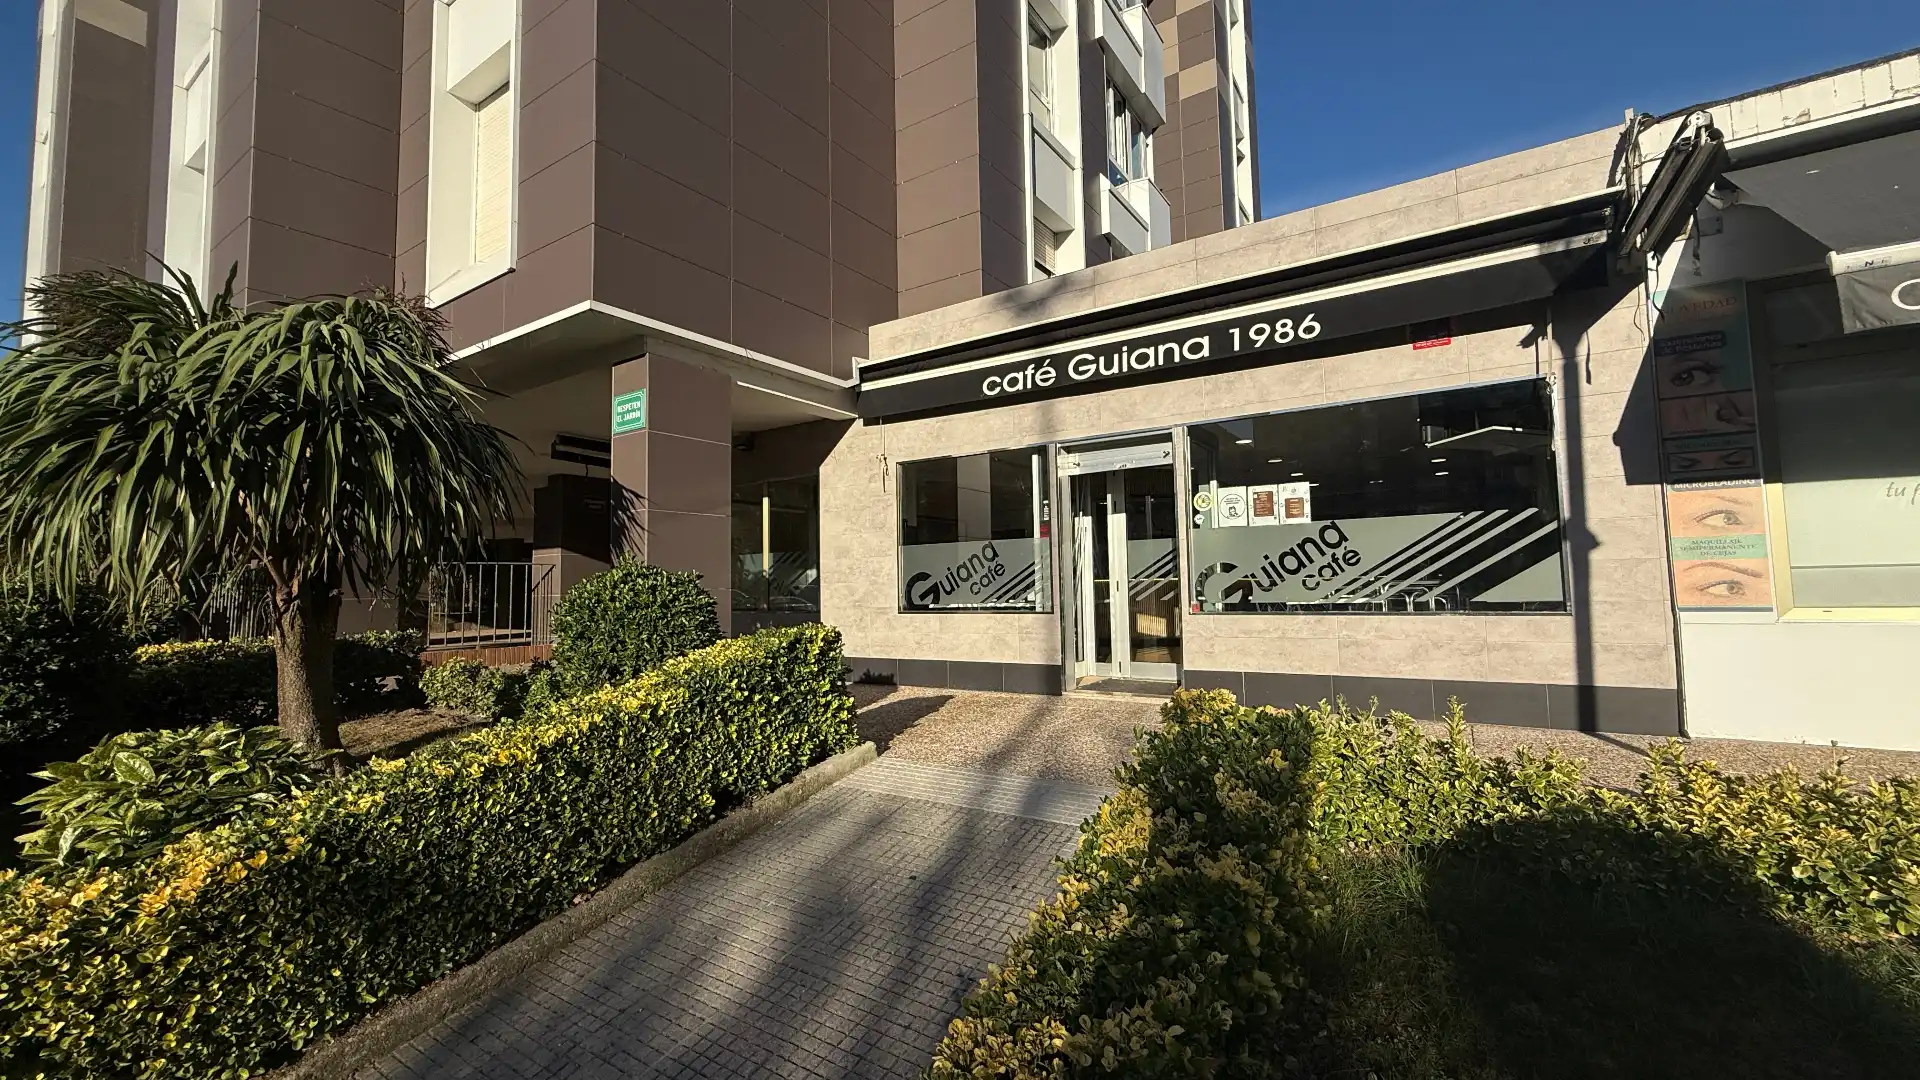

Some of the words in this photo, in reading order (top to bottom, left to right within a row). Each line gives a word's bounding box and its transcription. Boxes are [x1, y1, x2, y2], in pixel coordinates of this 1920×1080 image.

[982, 359, 1057, 396] café
[1067, 335, 1210, 381] Guiana
[1228, 313, 1321, 352] 1986
[617, 401, 641, 413] RESPETEN
[1674, 478, 1755, 489] MICROBLADING
[1886, 481, 1907, 498] tu
[905, 541, 1000, 608] Guiana
[970, 561, 1005, 595] café
[1195, 520, 1349, 604] Guiana
[1302, 546, 1361, 591] café
